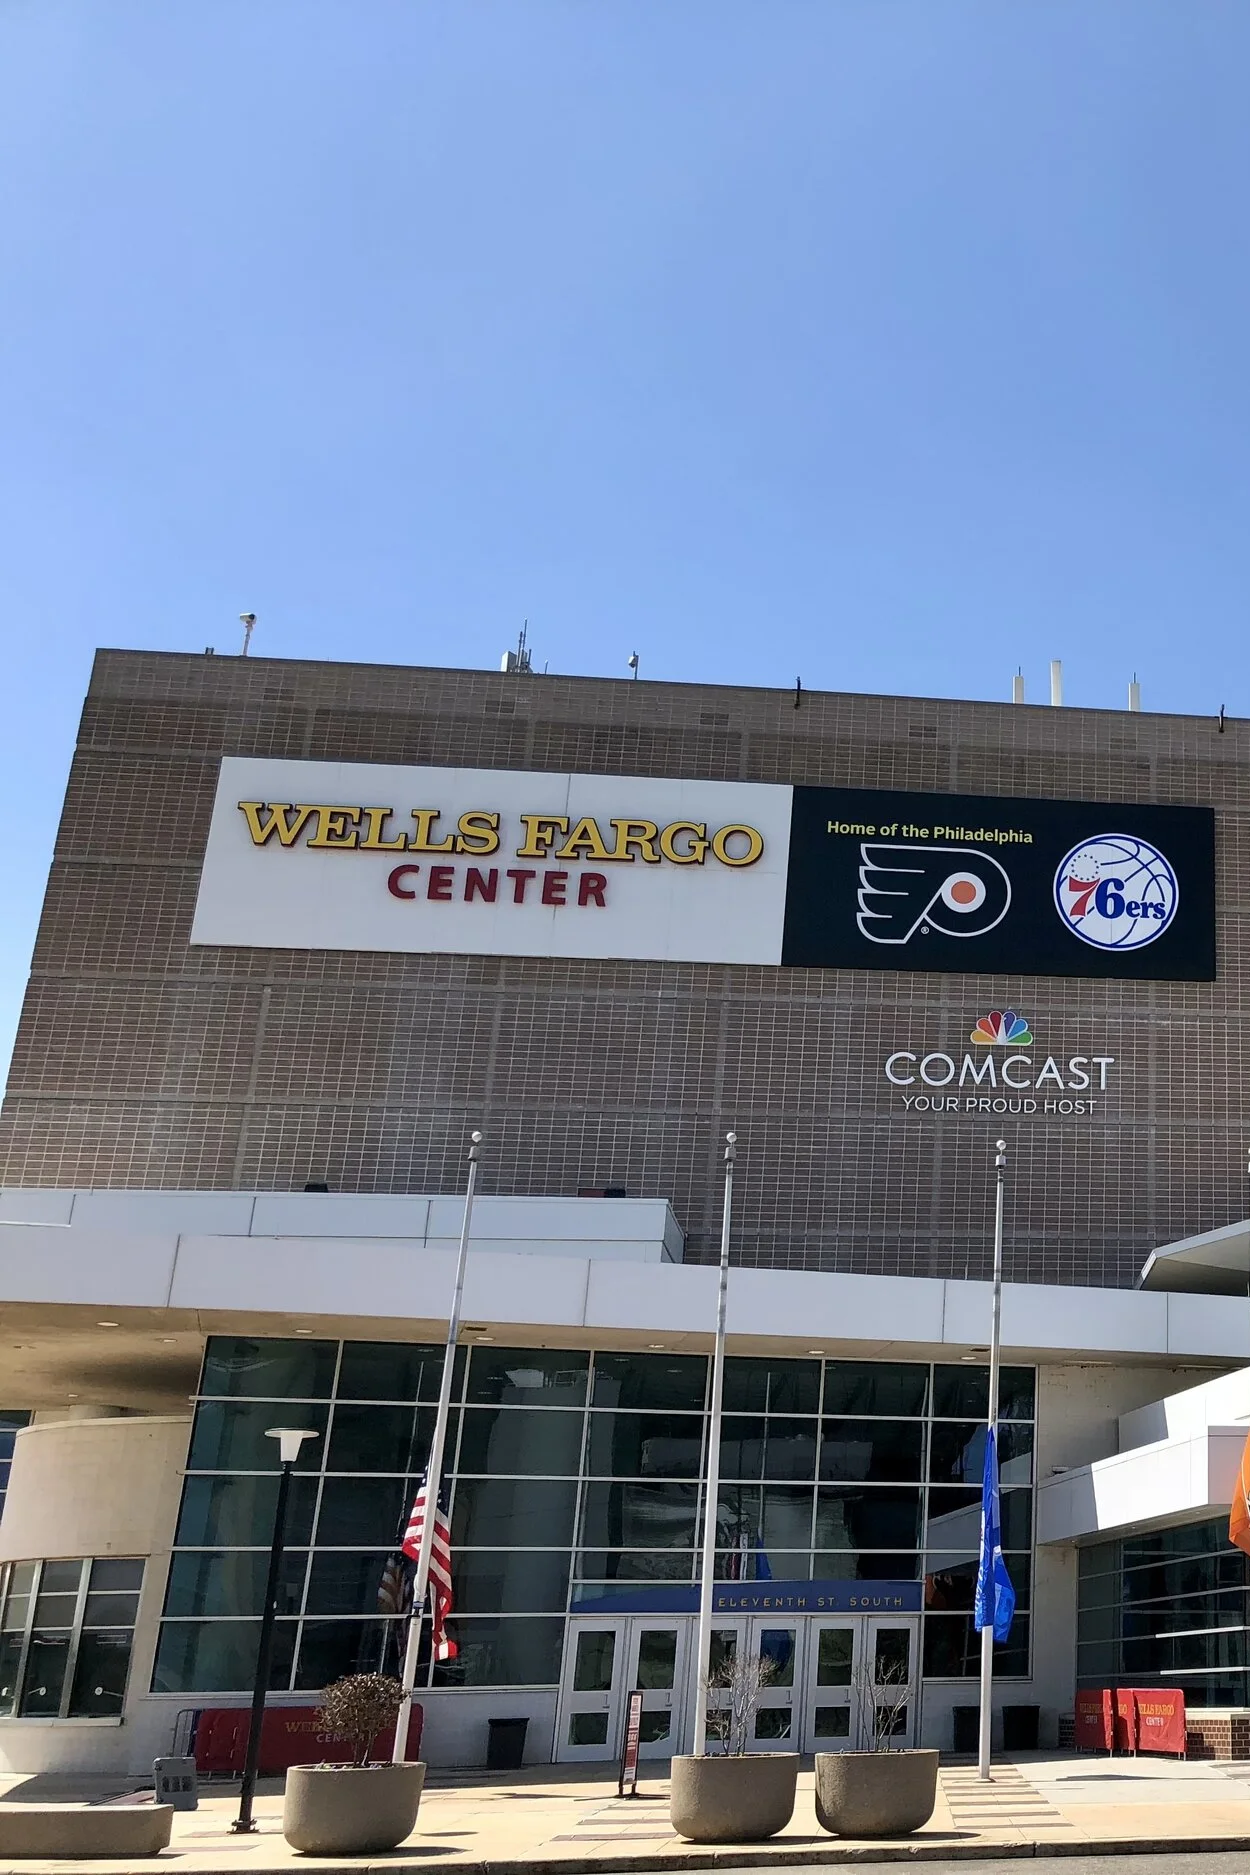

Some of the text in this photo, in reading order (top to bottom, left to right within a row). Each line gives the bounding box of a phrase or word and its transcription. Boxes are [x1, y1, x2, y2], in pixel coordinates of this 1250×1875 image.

[238, 801, 765, 867] WELLS FARGO
[827, 820, 1033, 845] Home of the Philadelphia
[387, 864, 608, 908] CENTER
[1068, 875, 1167, 920] 76ers
[885, 1051, 1115, 1091] COMCAST
[902, 1095, 1097, 1115] YOUR PROUD HOST
[718, 1597, 806, 1607] ELEVENTH
[850, 1597, 902, 1607] SOUTH
